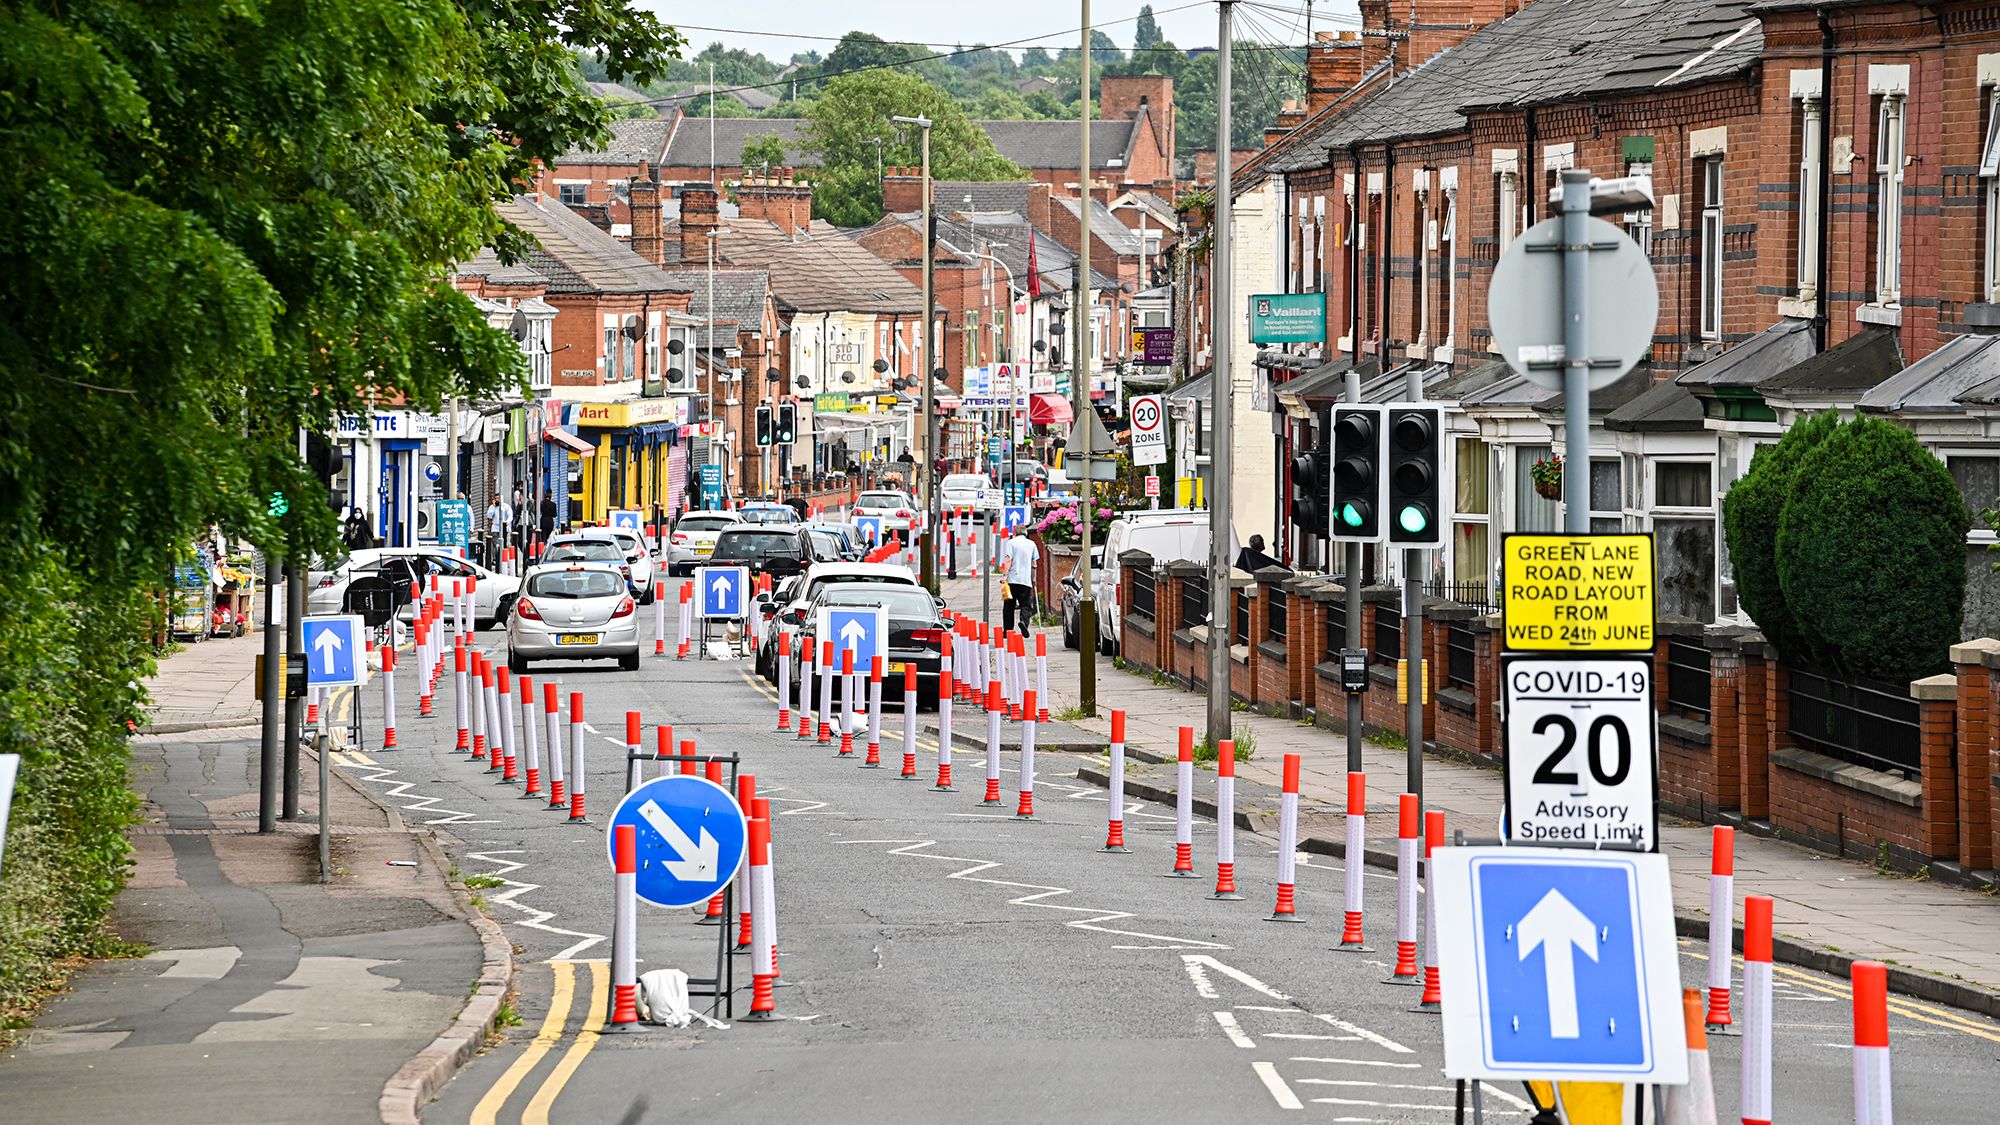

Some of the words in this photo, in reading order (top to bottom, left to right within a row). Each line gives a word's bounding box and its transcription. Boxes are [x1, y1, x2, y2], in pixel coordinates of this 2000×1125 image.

[1272, 307, 1322, 317] Vaillant
[836, 345, 852, 353] STD
[579, 408, 609, 419] Mart
[1137, 407, 1156, 421] 20
[1135, 433, 1160, 443] ZONE
[1518, 546, 1585, 561] GREEN
[1592, 546, 1639, 561] LANE
[1525, 566, 1586, 583] ROAD,
[1593, 566, 1633, 580] NEW
[1512, 586, 1568, 600] ROAD
[1575, 585, 1646, 600] LAYOUT
[1554, 606, 1608, 620] FROM
[1509, 626, 1553, 640] WED
[1560, 626, 1597, 640] 24th
[1603, 626, 1650, 640] JUNE
[1513, 671, 1645, 693] COVID-19
[1532, 714, 1631, 786] 20
[1535, 801, 1629, 822] Advisory
[1521, 821, 1585, 840] Speed
[1594, 823, 1644, 840] Limit
